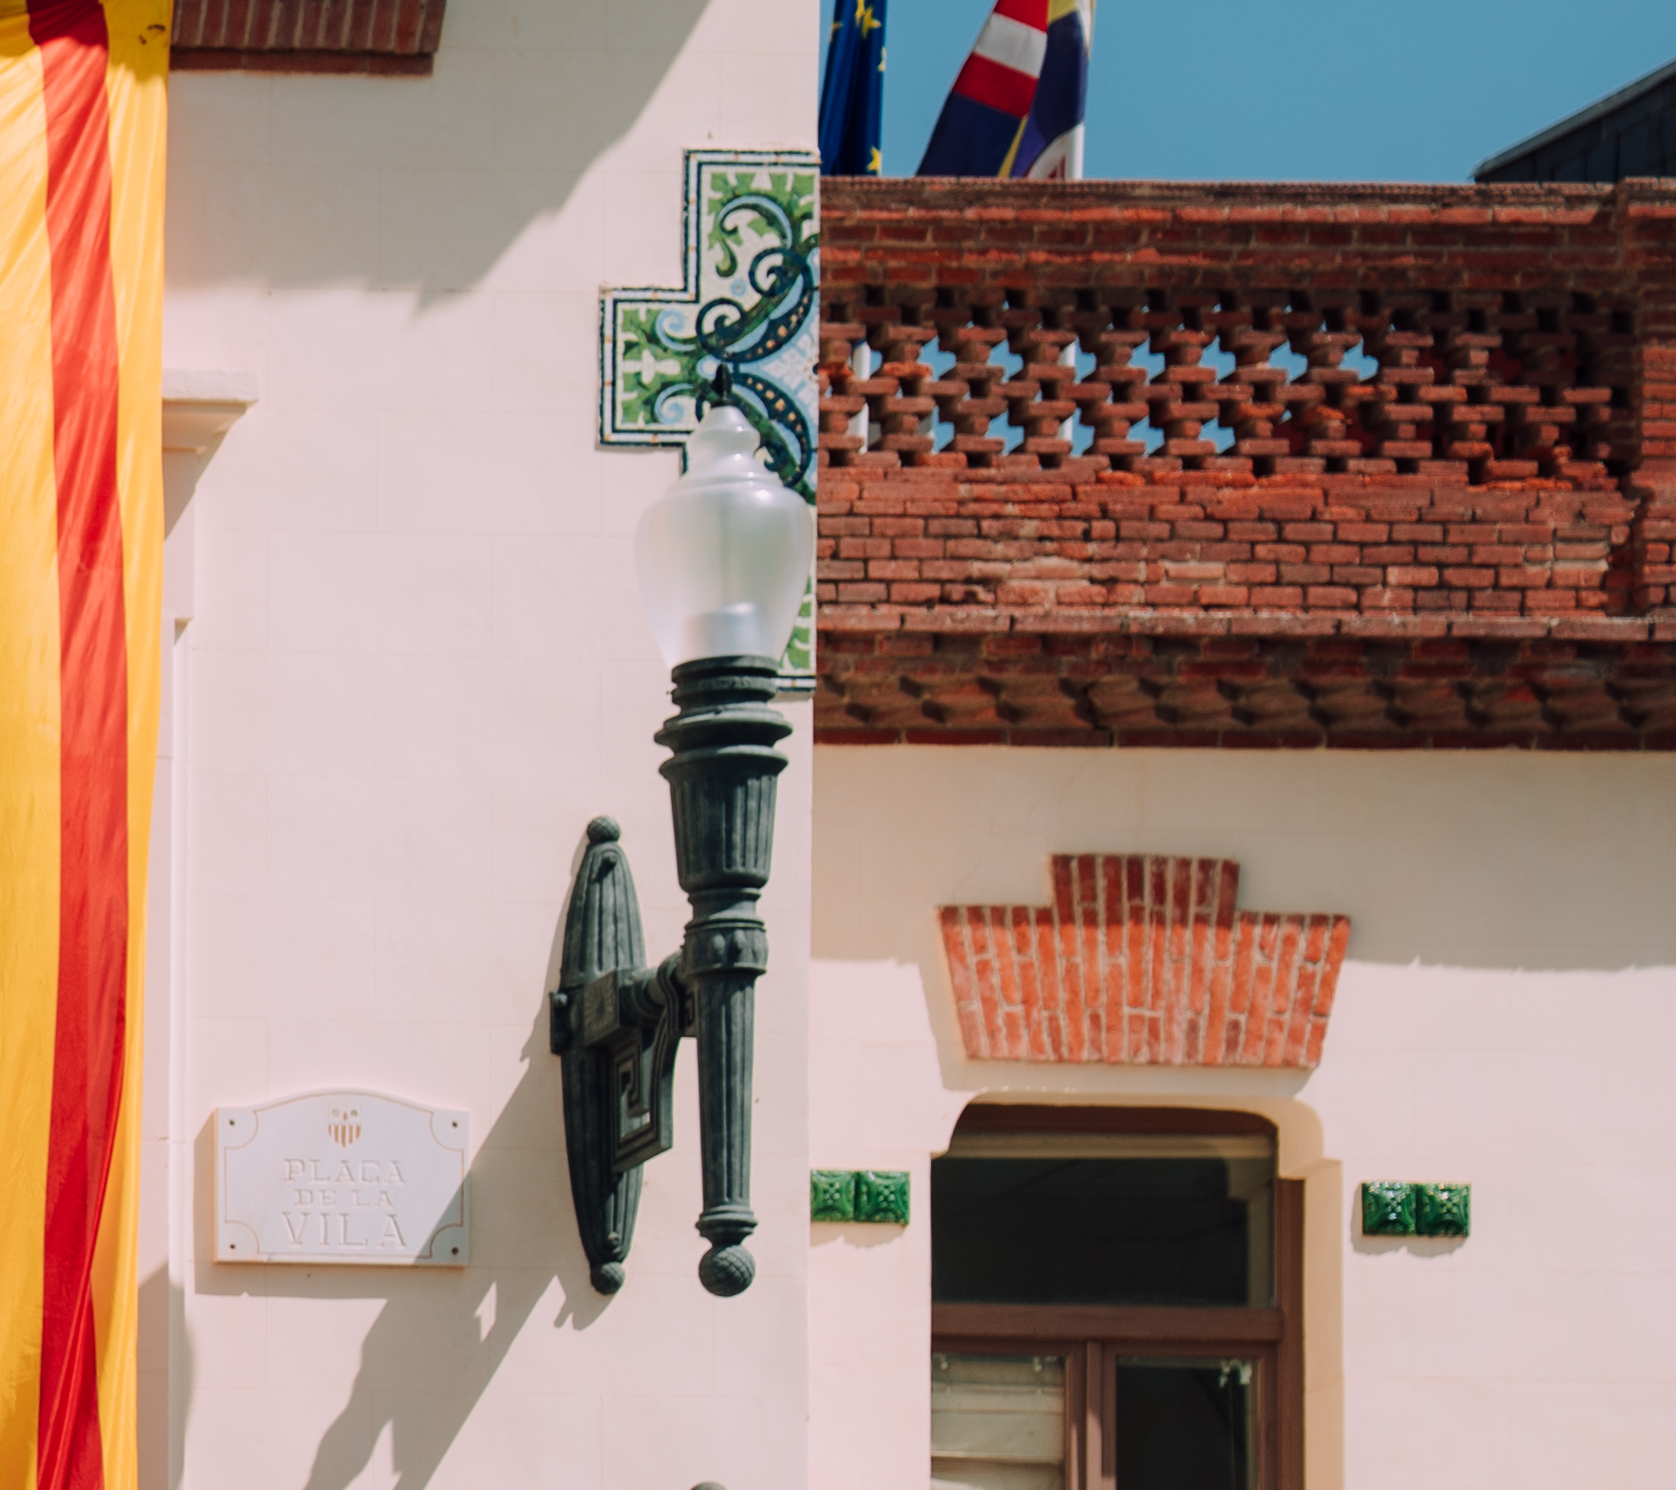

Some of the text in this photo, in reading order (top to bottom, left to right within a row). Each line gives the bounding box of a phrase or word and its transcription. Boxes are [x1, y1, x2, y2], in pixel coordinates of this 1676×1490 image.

[294, 1188, 394, 1208] DE LA
[281, 1211, 407, 1248] VILA
